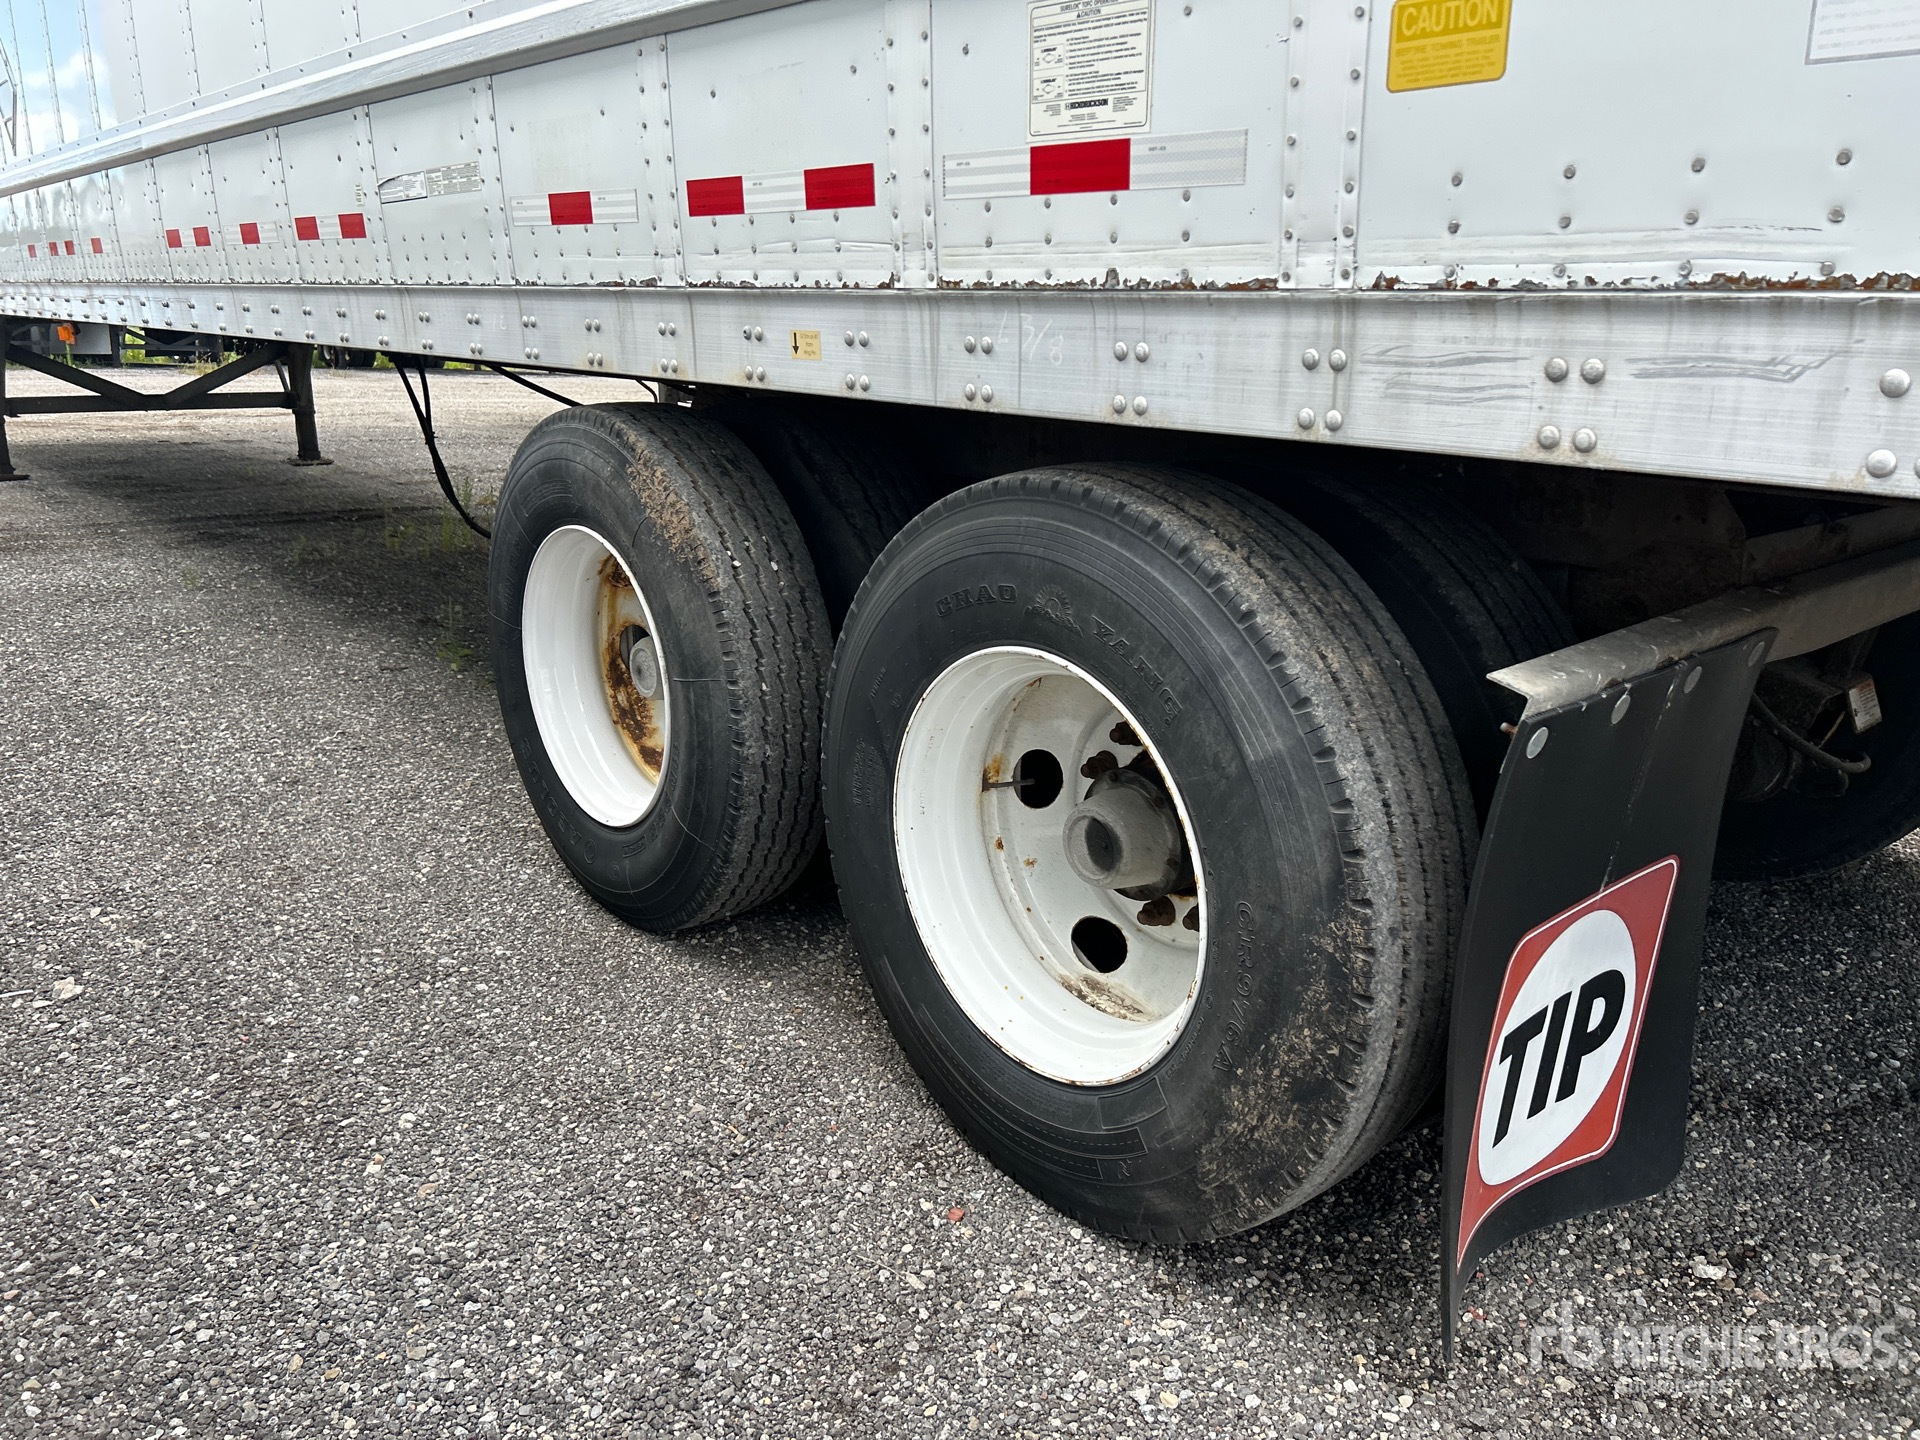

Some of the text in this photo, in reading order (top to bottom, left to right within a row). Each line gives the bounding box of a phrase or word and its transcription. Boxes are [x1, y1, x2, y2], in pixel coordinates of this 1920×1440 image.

[1080, 8, 1102, 18] CAUTION
[1401, 0, 1500, 36] CAUTION
[935, 583, 1018, 618] CHAO
[1090, 615, 1185, 724] YANG
[1212, 899, 1256, 1073] CR976A
[1492, 968, 1627, 1149] TIP
